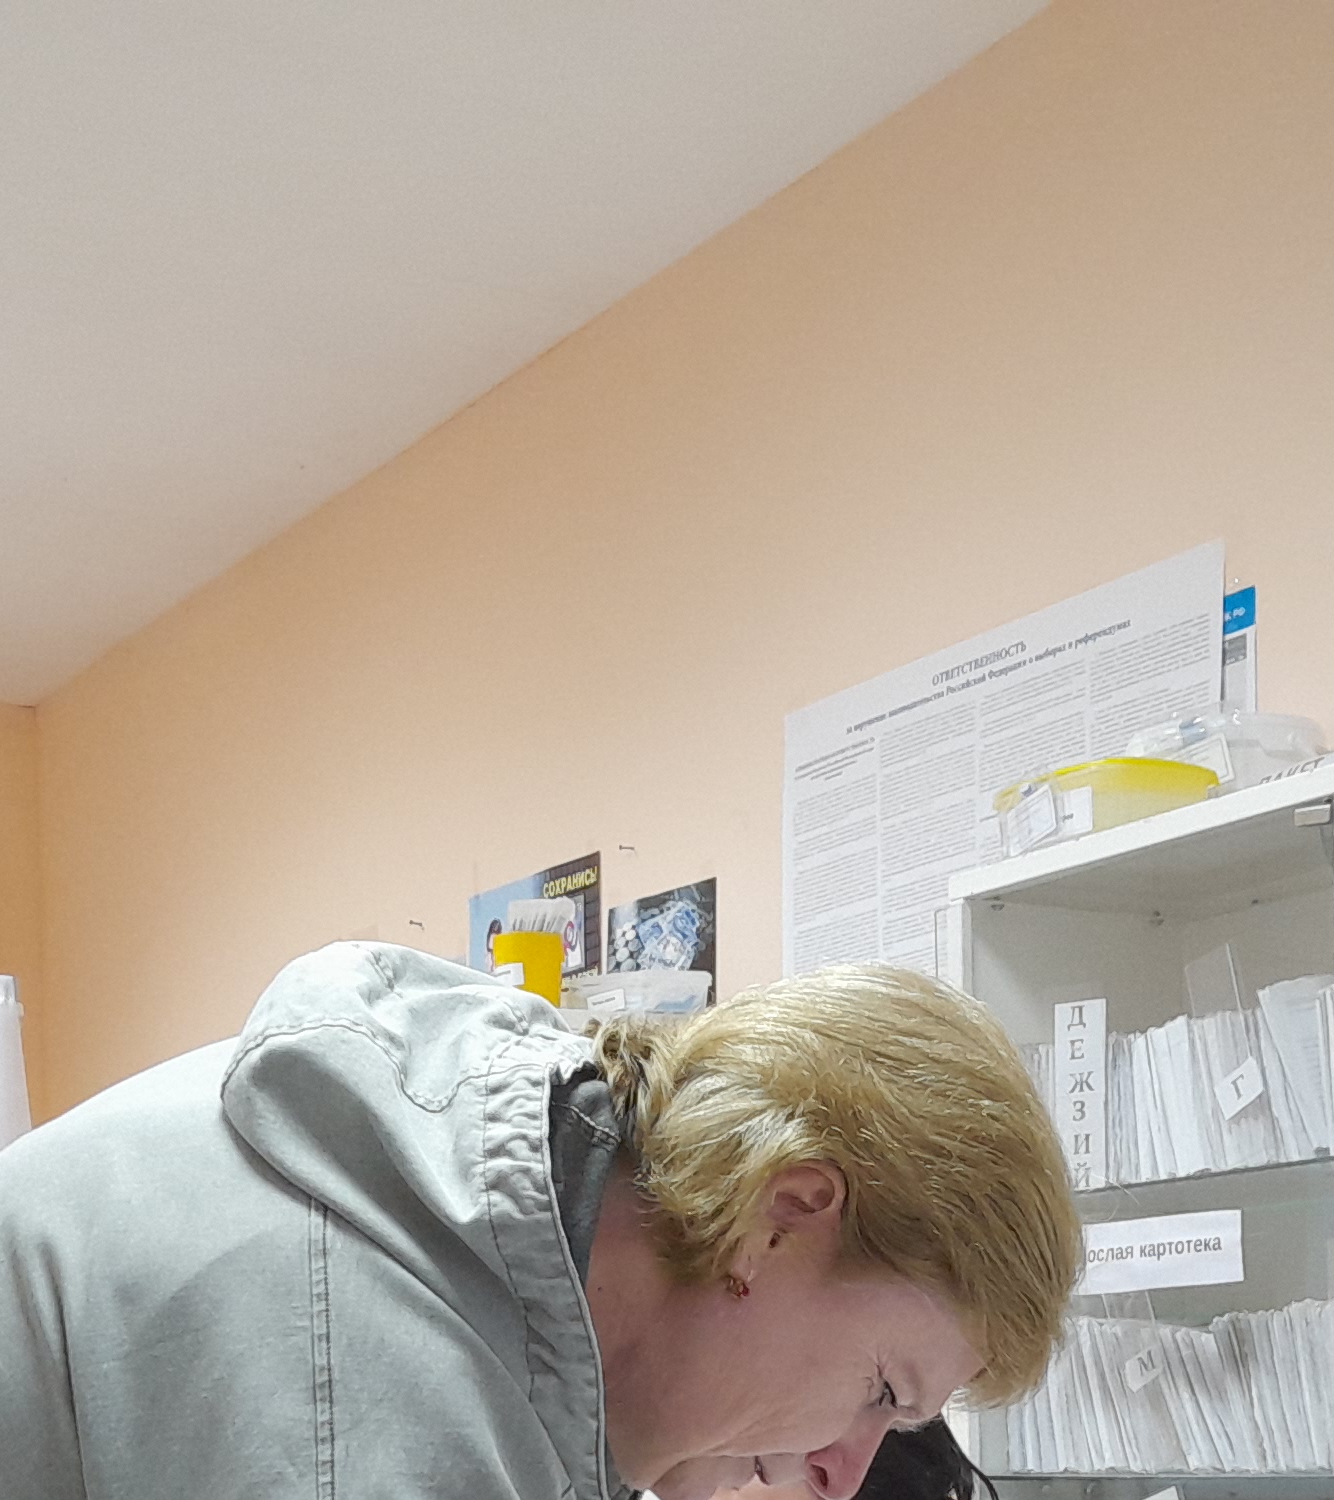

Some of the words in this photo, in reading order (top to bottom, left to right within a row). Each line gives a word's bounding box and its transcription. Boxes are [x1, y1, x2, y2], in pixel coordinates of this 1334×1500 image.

[1229, 1073, 1245, 1101] Г
[1087, 1244, 1134, 1264] ослая
[1139, 1236, 1223, 1262] картотека
[1137, 1353, 1156, 1377] М
